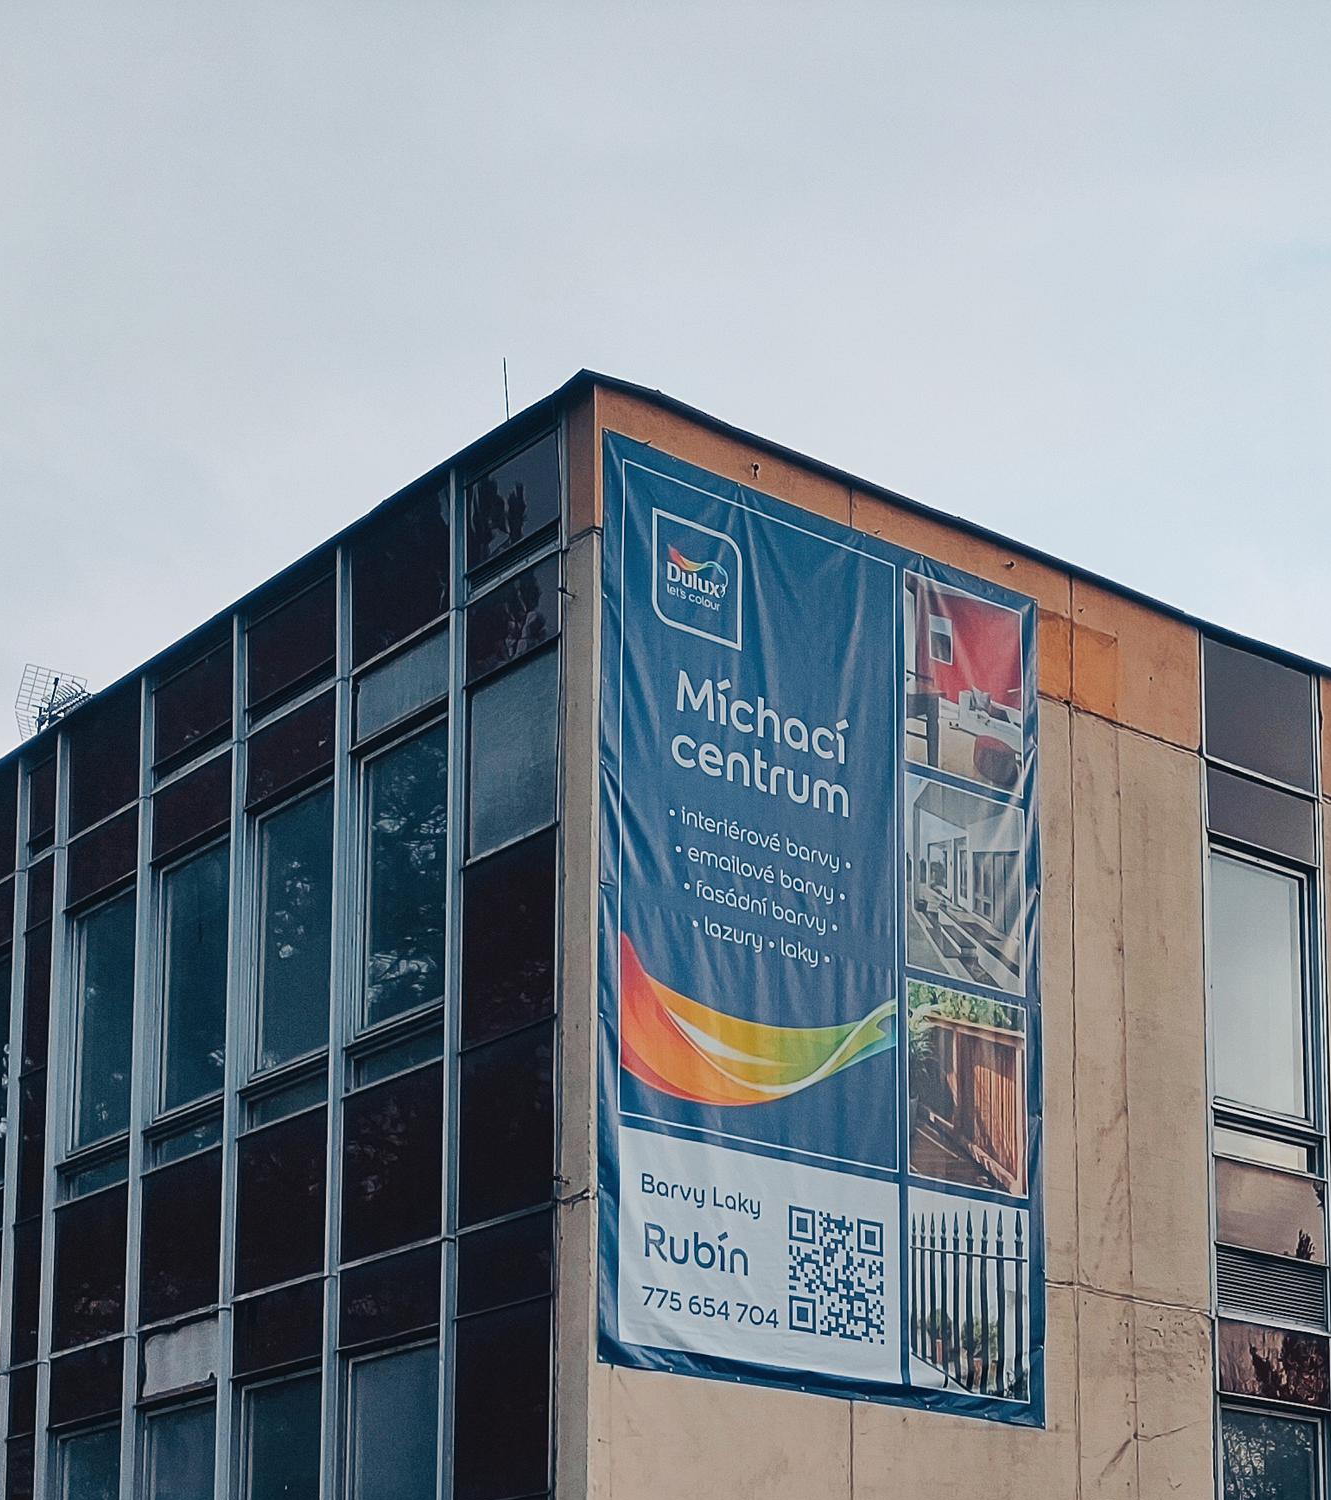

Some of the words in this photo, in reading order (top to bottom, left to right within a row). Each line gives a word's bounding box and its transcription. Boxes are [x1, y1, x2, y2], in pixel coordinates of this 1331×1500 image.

[666, 561, 721, 598] Dulux
[666, 583, 687, 600] let's
[688, 593, 721, 612] colour
[677, 669, 850, 764] Míchací
[671, 734, 850, 818] centrum
[681, 806, 781, 852] interiérové
[786, 837, 840, 873] barvy
[687, 845, 775, 883] emailové
[780, 869, 834, 904] barvy
[696, 880, 767, 916] fasádní
[772, 900, 826, 935] barvy
[705, 915, 763, 953] lazury
[780, 937, 819, 968] laky
[641, 1173, 705, 1208] Barvy
[713, 1186, 761, 1220] Laky
[644, 1221, 749, 1276] Rubín
[642, 1285, 682, 1311] 775
[688, 1295, 730, 1321] 654
[736, 1302, 780, 1328] 704
